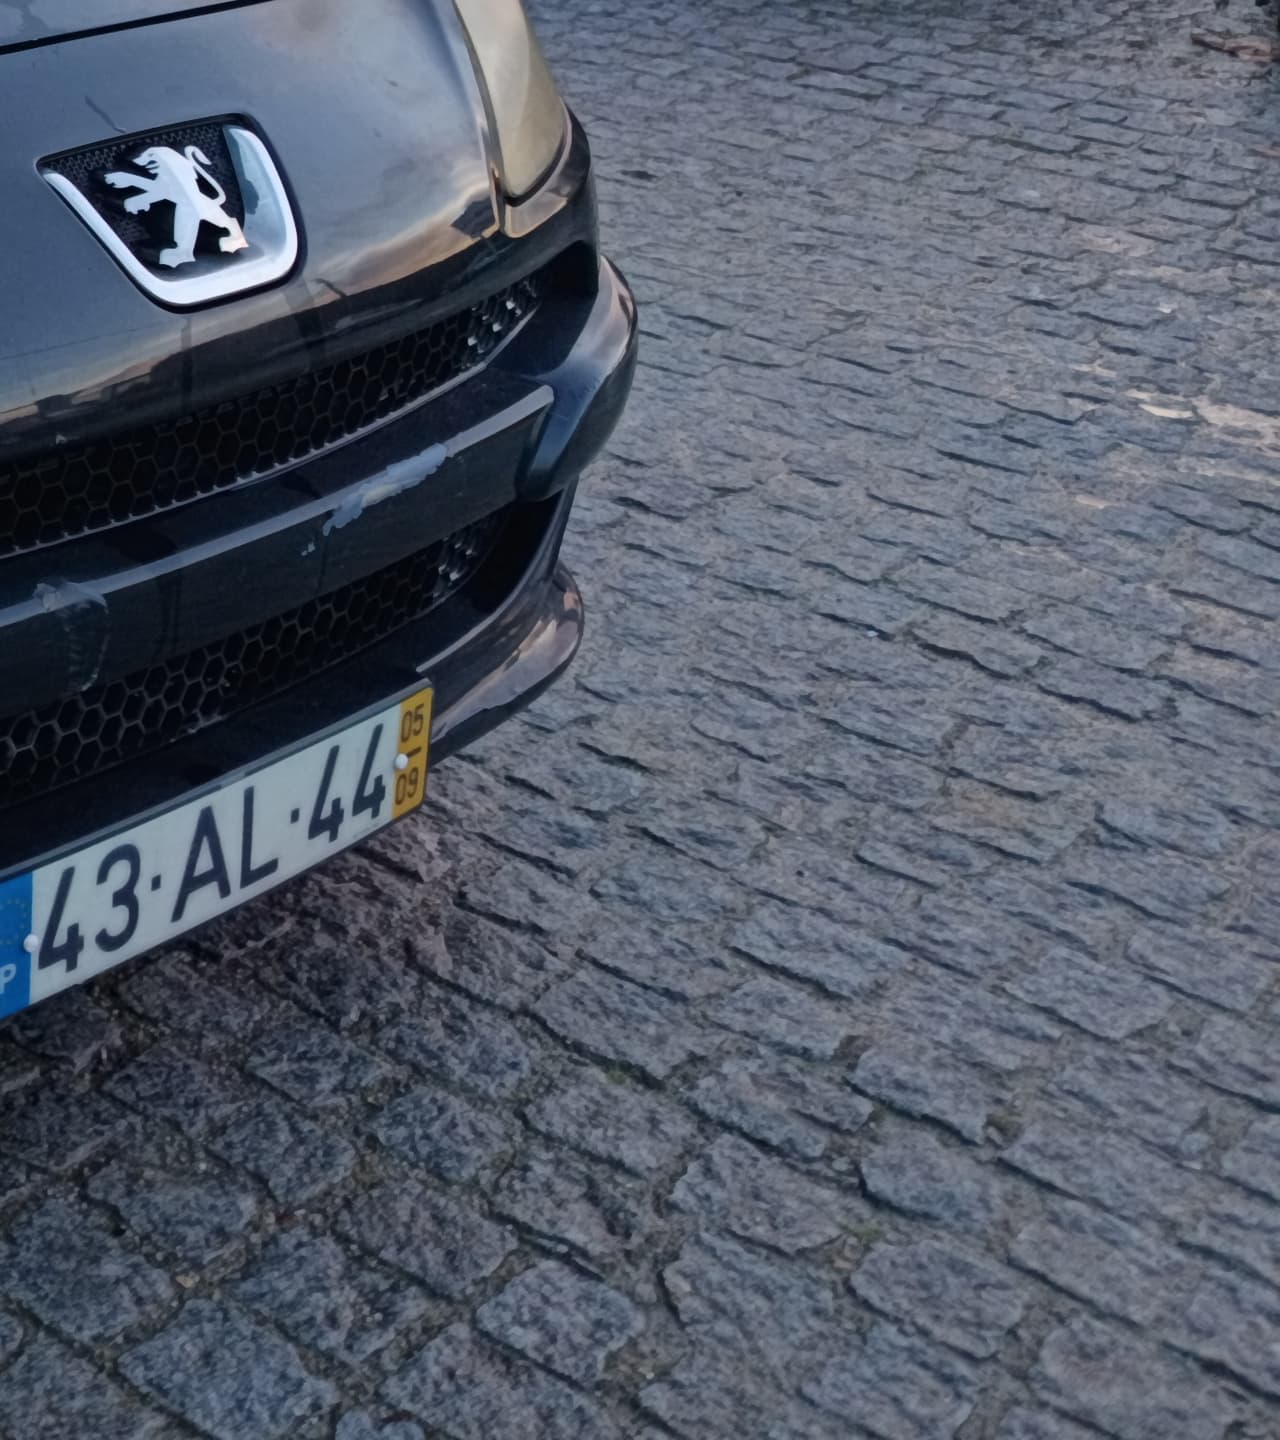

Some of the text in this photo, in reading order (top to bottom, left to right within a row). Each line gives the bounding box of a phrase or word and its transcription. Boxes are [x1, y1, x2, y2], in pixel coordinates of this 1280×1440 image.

[401, 704, 424, 743] 05
[395, 767, 419, 806] 09
[0, 964, 16, 995] P
